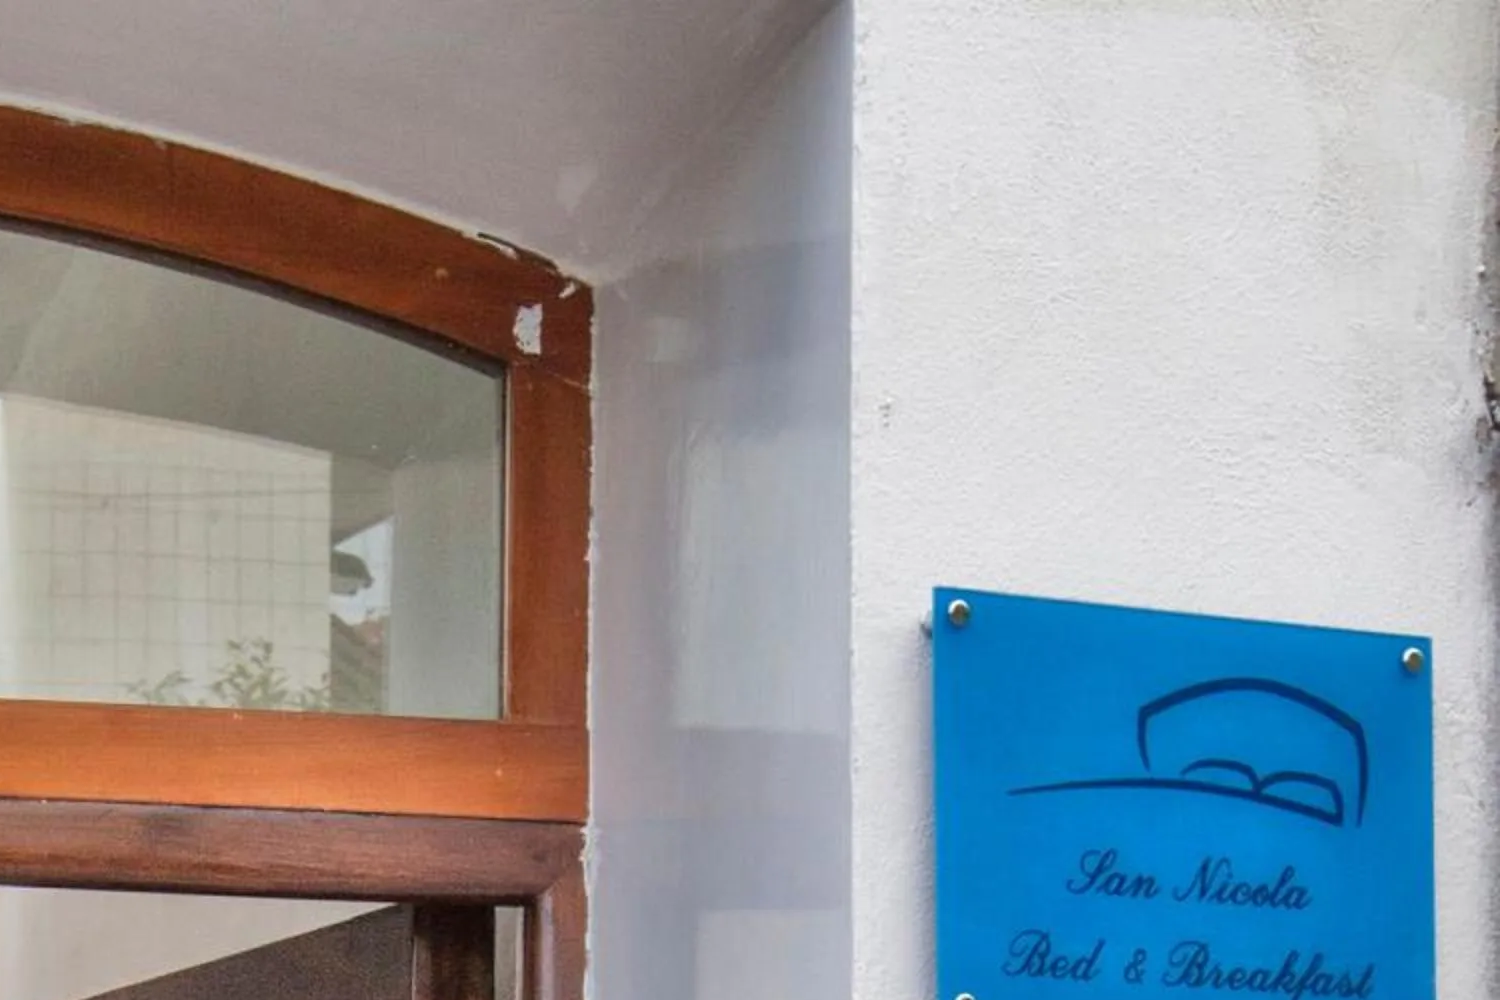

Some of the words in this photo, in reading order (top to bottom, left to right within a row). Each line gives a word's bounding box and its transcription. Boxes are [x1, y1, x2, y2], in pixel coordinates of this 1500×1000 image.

[1066, 848, 1161, 899] San
[1171, 857, 1313, 910] Nicola
[1001, 929, 1106, 982] Bed
[1123, 948, 1147, 984] &
